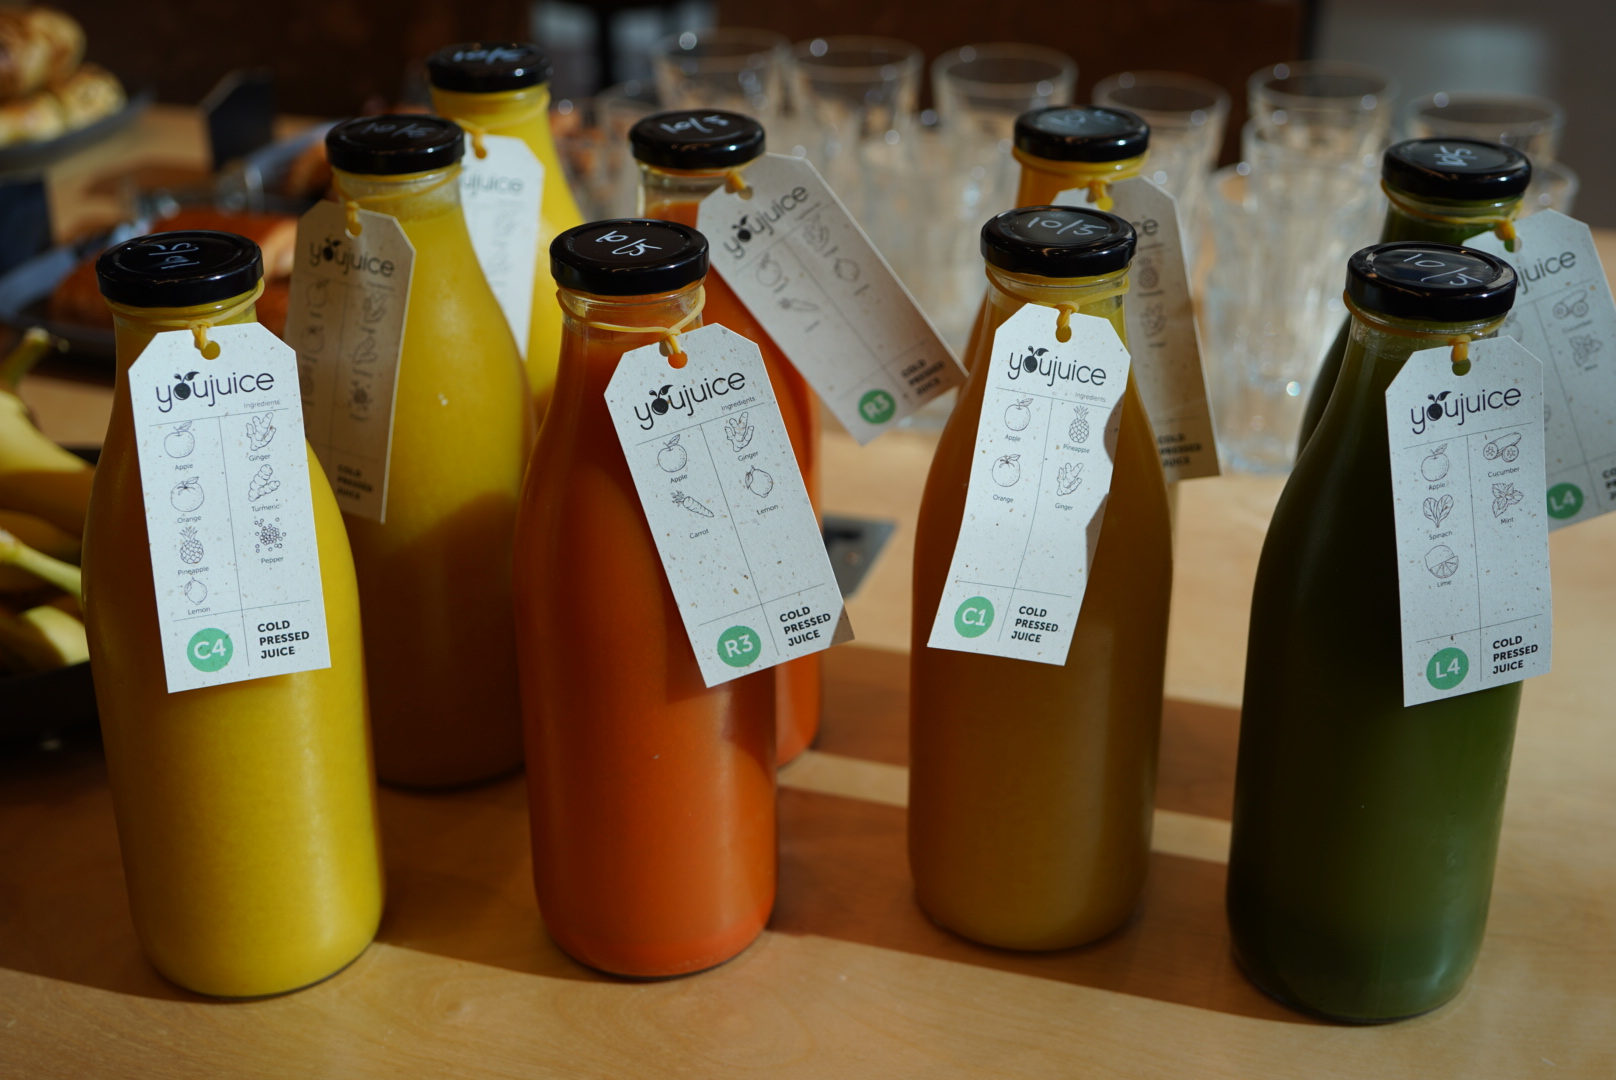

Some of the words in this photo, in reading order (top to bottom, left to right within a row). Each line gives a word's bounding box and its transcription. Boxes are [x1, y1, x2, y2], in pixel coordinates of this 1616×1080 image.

[659, 114, 729, 134] 10/5
[723, 186, 809, 260] youjuice
[1027, 216, 1107, 236] 10/5
[595, 230, 662, 257] 10/5
[309, 238, 395, 278] youjuice
[1403, 253, 1483, 286] 10/5
[1007, 346, 1107, 387] youjuice
[155, 371, 275, 413] youjuice
[634, 372, 746, 431] youjuice
[1410, 388, 1522, 435] youjuice
[1004, 433, 1022, 443] Apple
[1062, 443, 1091, 454] Pineapple
[248, 453, 271, 463] Ginger
[737, 450, 759, 462] Ginger
[174, 462, 194, 472] Apple
[1487, 466, 1520, 479] Cucumber
[669, 473, 689, 484] Apple
[1427, 481, 1446, 491] Apple
[992, 494, 1014, 505] Orange
[1054, 502, 1074, 511] Ginger
[250, 503, 281, 513] Turmeric
[756, 503, 779, 516] Lemon
[176, 514, 202, 525] Orange
[1500, 516, 1515, 525] Mint
[688, 527, 710, 540] Carrot
[1428, 529, 1453, 541] Spinach
[260, 555, 284, 565] Pepper
[177, 565, 210, 577] Pineapple
[1436, 579, 1452, 588] Lime
[187, 606, 211, 616] Lemon
[779, 606, 811, 623] COLD
[961, 606, 988, 627] C1
[1018, 605, 1048, 618] COLD
[257, 619, 291, 633] COLD
[783, 612, 831, 635] PRESSED
[1014, 617, 1059, 633] PRESSED
[259, 630, 310, 646] PRESSED
[787, 629, 821, 647] JUICE
[1010, 630, 1042, 643] JUICE
[1492, 635, 1523, 650] COLD
[193, 638, 227, 660] C4
[260, 646, 296, 660] JUICE
[724, 634, 754, 658] R3
[1492, 643, 1539, 662] PRESSED
[1435, 657, 1461, 679] L4
[1492, 659, 1524, 675] JUICE
